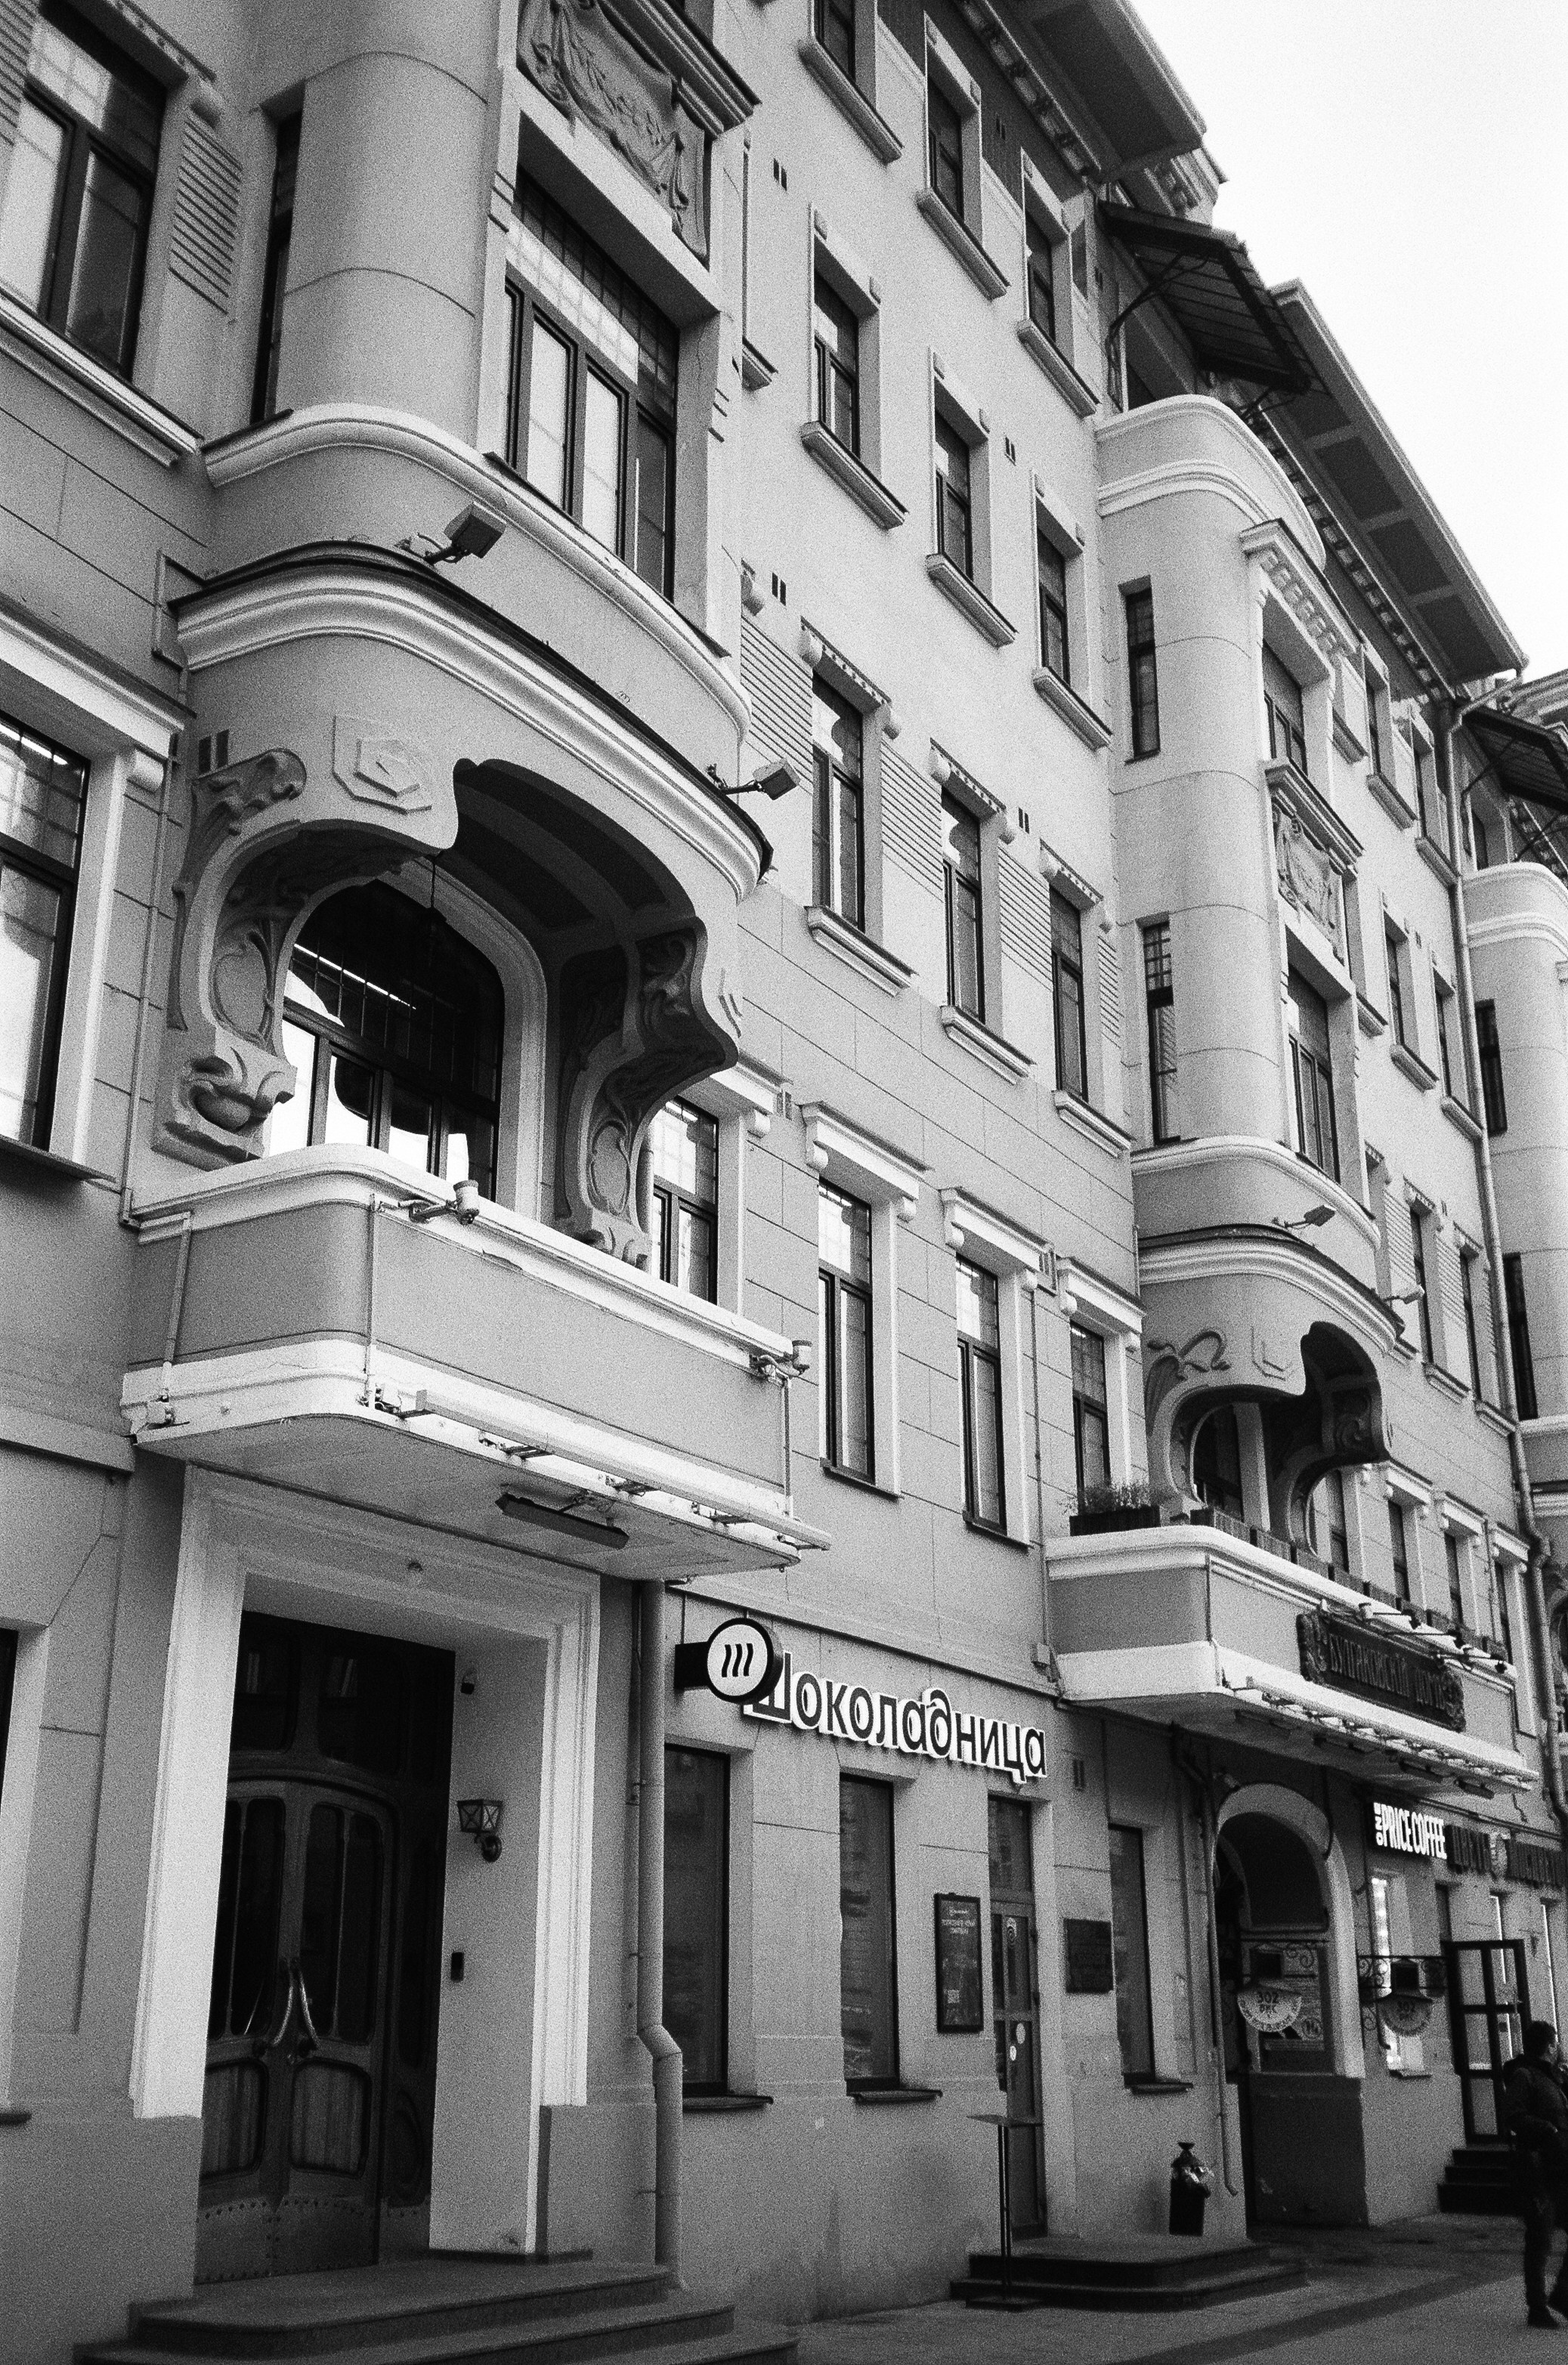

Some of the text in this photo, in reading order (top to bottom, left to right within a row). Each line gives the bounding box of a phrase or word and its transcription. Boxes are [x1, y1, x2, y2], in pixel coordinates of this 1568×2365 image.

[1381, 1804, 1413, 1852] PRICE
[1411, 1812, 1447, 1860] COFFEE
[1257, 1990, 1279, 2003] 302
